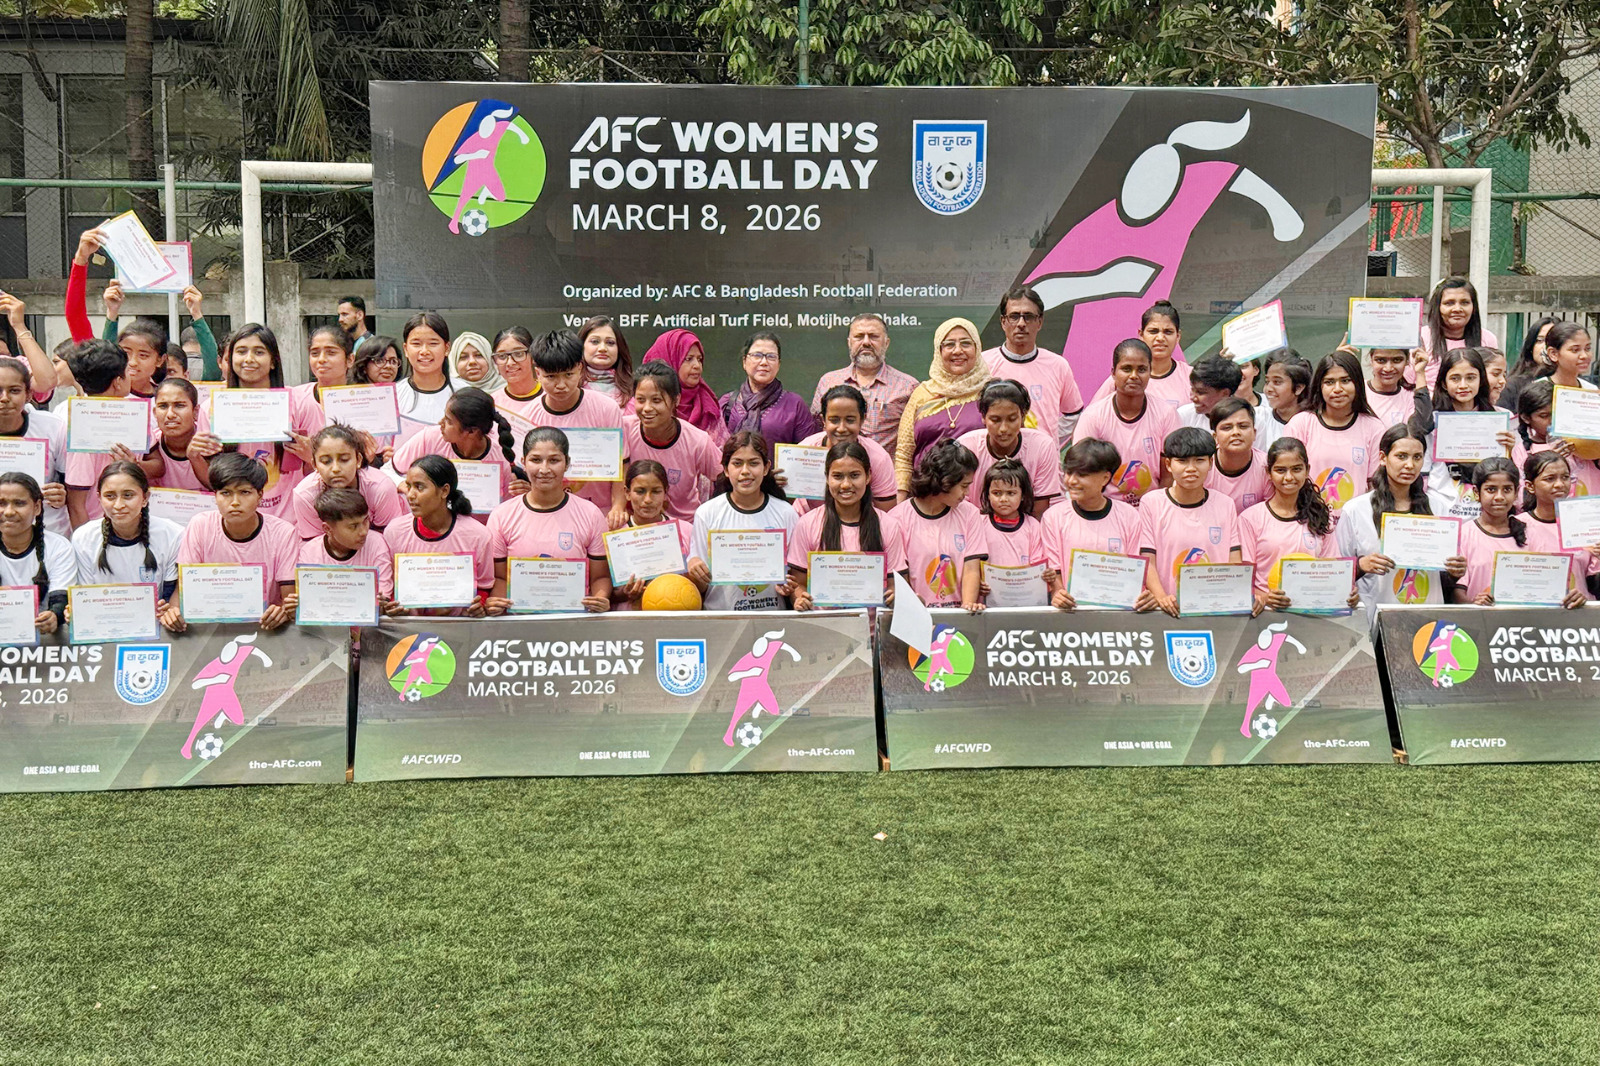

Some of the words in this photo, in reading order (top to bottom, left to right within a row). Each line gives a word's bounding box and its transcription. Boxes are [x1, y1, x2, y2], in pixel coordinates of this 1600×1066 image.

[571, 117, 661, 152] AFC
[671, 122, 878, 152] WOMEN'S
[570, 159, 783, 189] FOOTBALL
[795, 160, 878, 189] DAY
[916, 160, 935, 205] BANGLADESH
[933, 200, 969, 211] FOOTBALL
[967, 161, 983, 203] FEDERATION
[573, 204, 688, 230] MARCH
[701, 205, 726, 234] 8,
[747, 205, 820, 230] 2026
[563, 284, 642, 301] Organized
[647, 284, 668, 301] by:
[672, 285, 701, 298] AFC
[705, 285, 716, 298] &
[721, 284, 809, 301] Bangladesh
[814, 284, 873, 298] Football
[878, 284, 958, 298] Federation
[619, 314, 649, 327] BFF
[653, 314, 715, 327] Artificial
[719, 314, 750, 327] Turf
[753, 314, 793, 328] Field,
[734, 603, 765, 611] FOOTBALL
[987, 630, 1035, 648] AFC
[1040, 632, 1153, 648] WOMEN'S
[1489, 627, 1536, 645] AFC
[1539, 628, 1600, 644] WOM
[0, 645, 103, 664] OMEN'S
[470, 640, 521, 658] AFC
[527, 640, 643, 657] WOMEN'S
[987, 650, 1104, 667] FOOTBALL
[1109, 650, 1154, 665] DAY
[49, 665, 102, 683] DAY
[469, 660, 590, 677] FOOTBALL
[596, 659, 643, 674] DAY
[1494, 667, 1561, 682] MARCH
[1565, 667, 1581, 683] 8,
[989, 672, 1055, 686] MARCH
[1062, 671, 1076, 687] 8,
[1087, 671, 1130, 684] 2026
[19, 688, 68, 705] 2026
[468, 682, 537, 696] MARCH
[544, 681, 559, 697] 8,
[571, 680, 615, 694] 2026
[935, 744, 991, 753] #AFCWFD
[1104, 741, 1118, 750] ONE
[1119, 741, 1134, 750] ASIA
[1141, 741, 1155, 750] ONE
[1156, 740, 1172, 749] GOAL
[1304, 740, 1369, 748] the-AFC.com
[1451, 738, 1506, 747] #AFCWFD
[402, 754, 461, 764] #AFCWFD
[579, 751, 594, 760] ONE
[594, 751, 610, 760] ASIA
[618, 751, 632, 759] ONE
[632, 750, 650, 759] GOAL
[788, 748, 854, 756] the-AFC.com
[24, 766, 38, 775] ONE
[39, 766, 57, 774] ASIA
[65, 765, 80, 773] ONE
[249, 760, 321, 769] the-AFC.com
